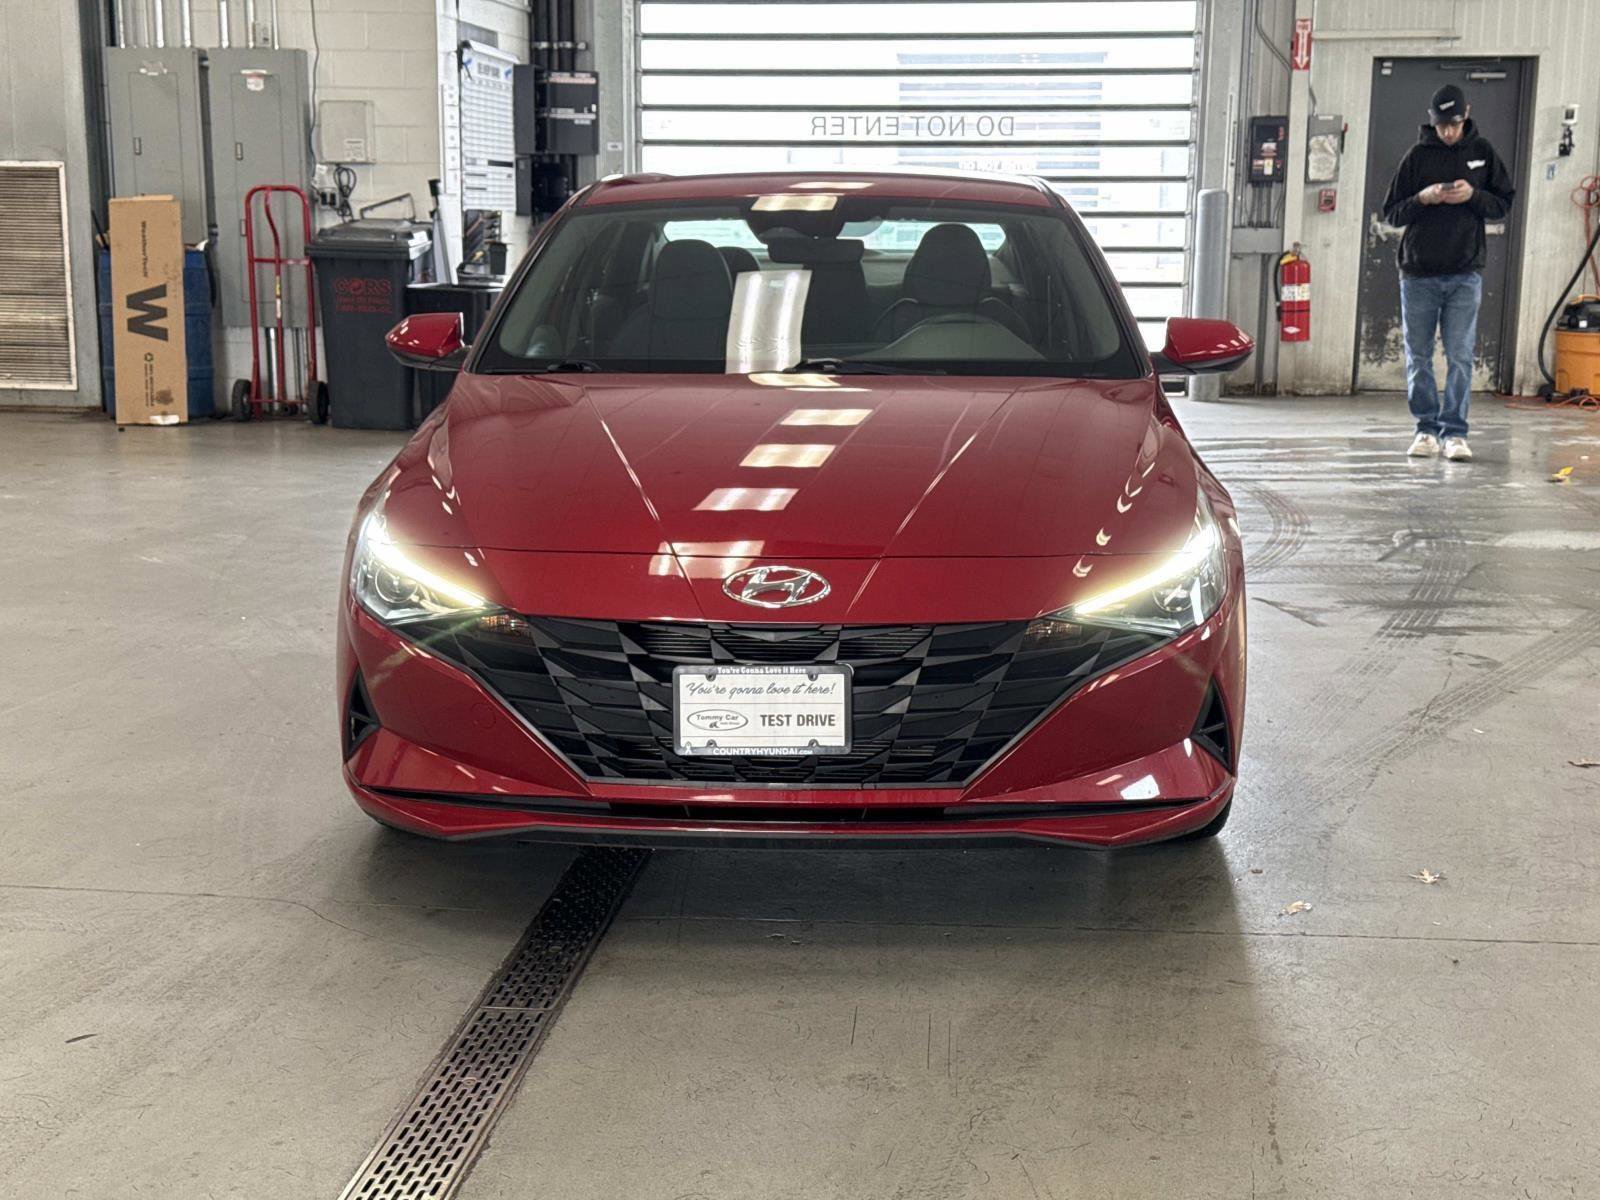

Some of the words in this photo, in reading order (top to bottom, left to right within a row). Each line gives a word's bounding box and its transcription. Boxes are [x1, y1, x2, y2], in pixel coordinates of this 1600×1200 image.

[126, 283, 169, 342] W
[686, 682, 727, 696] You're
[728, 686, 765, 700] gonna
[765, 682, 791, 695] love
[792, 683, 805, 695] it
[804, 683, 836, 695] here!
[760, 714, 793, 727] TEST
[796, 714, 836, 727] DRIVE
